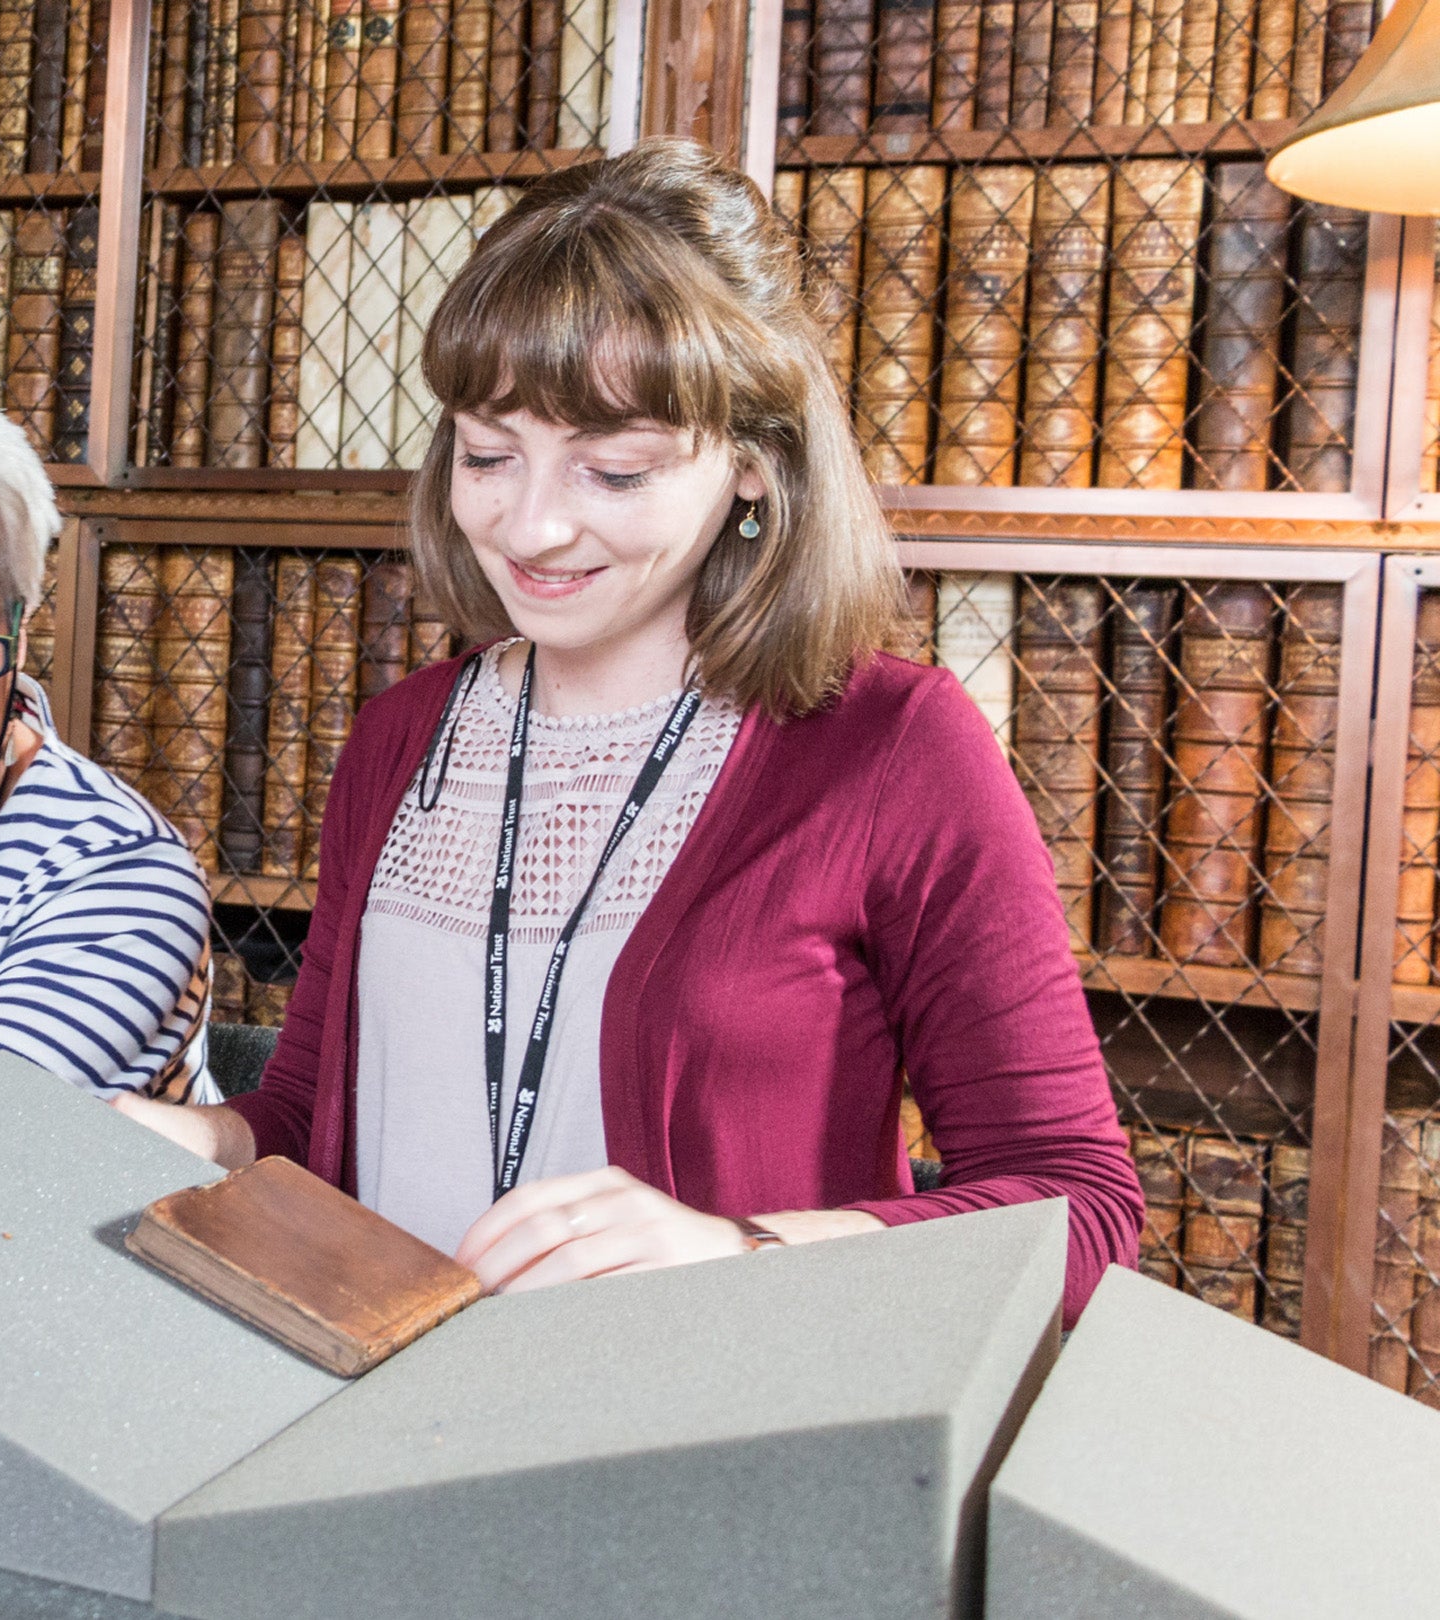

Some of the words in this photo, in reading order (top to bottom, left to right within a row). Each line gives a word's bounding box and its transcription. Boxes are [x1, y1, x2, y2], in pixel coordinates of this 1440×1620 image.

[513, 696, 530, 744] National
[668, 685, 702, 735] National
[652, 733, 678, 761] Trust
[504, 798, 517, 830] Trust
[499, 829, 515, 874] National
[490, 933, 505, 965] Trust
[489, 967, 504, 1018] National
[539, 956, 561, 1009] National
[532, 1006, 552, 1041] Trust
[490, 1081, 498, 1112] Trust
[507, 1103, 532, 1160] National
[501, 1157, 518, 1190] Trust
